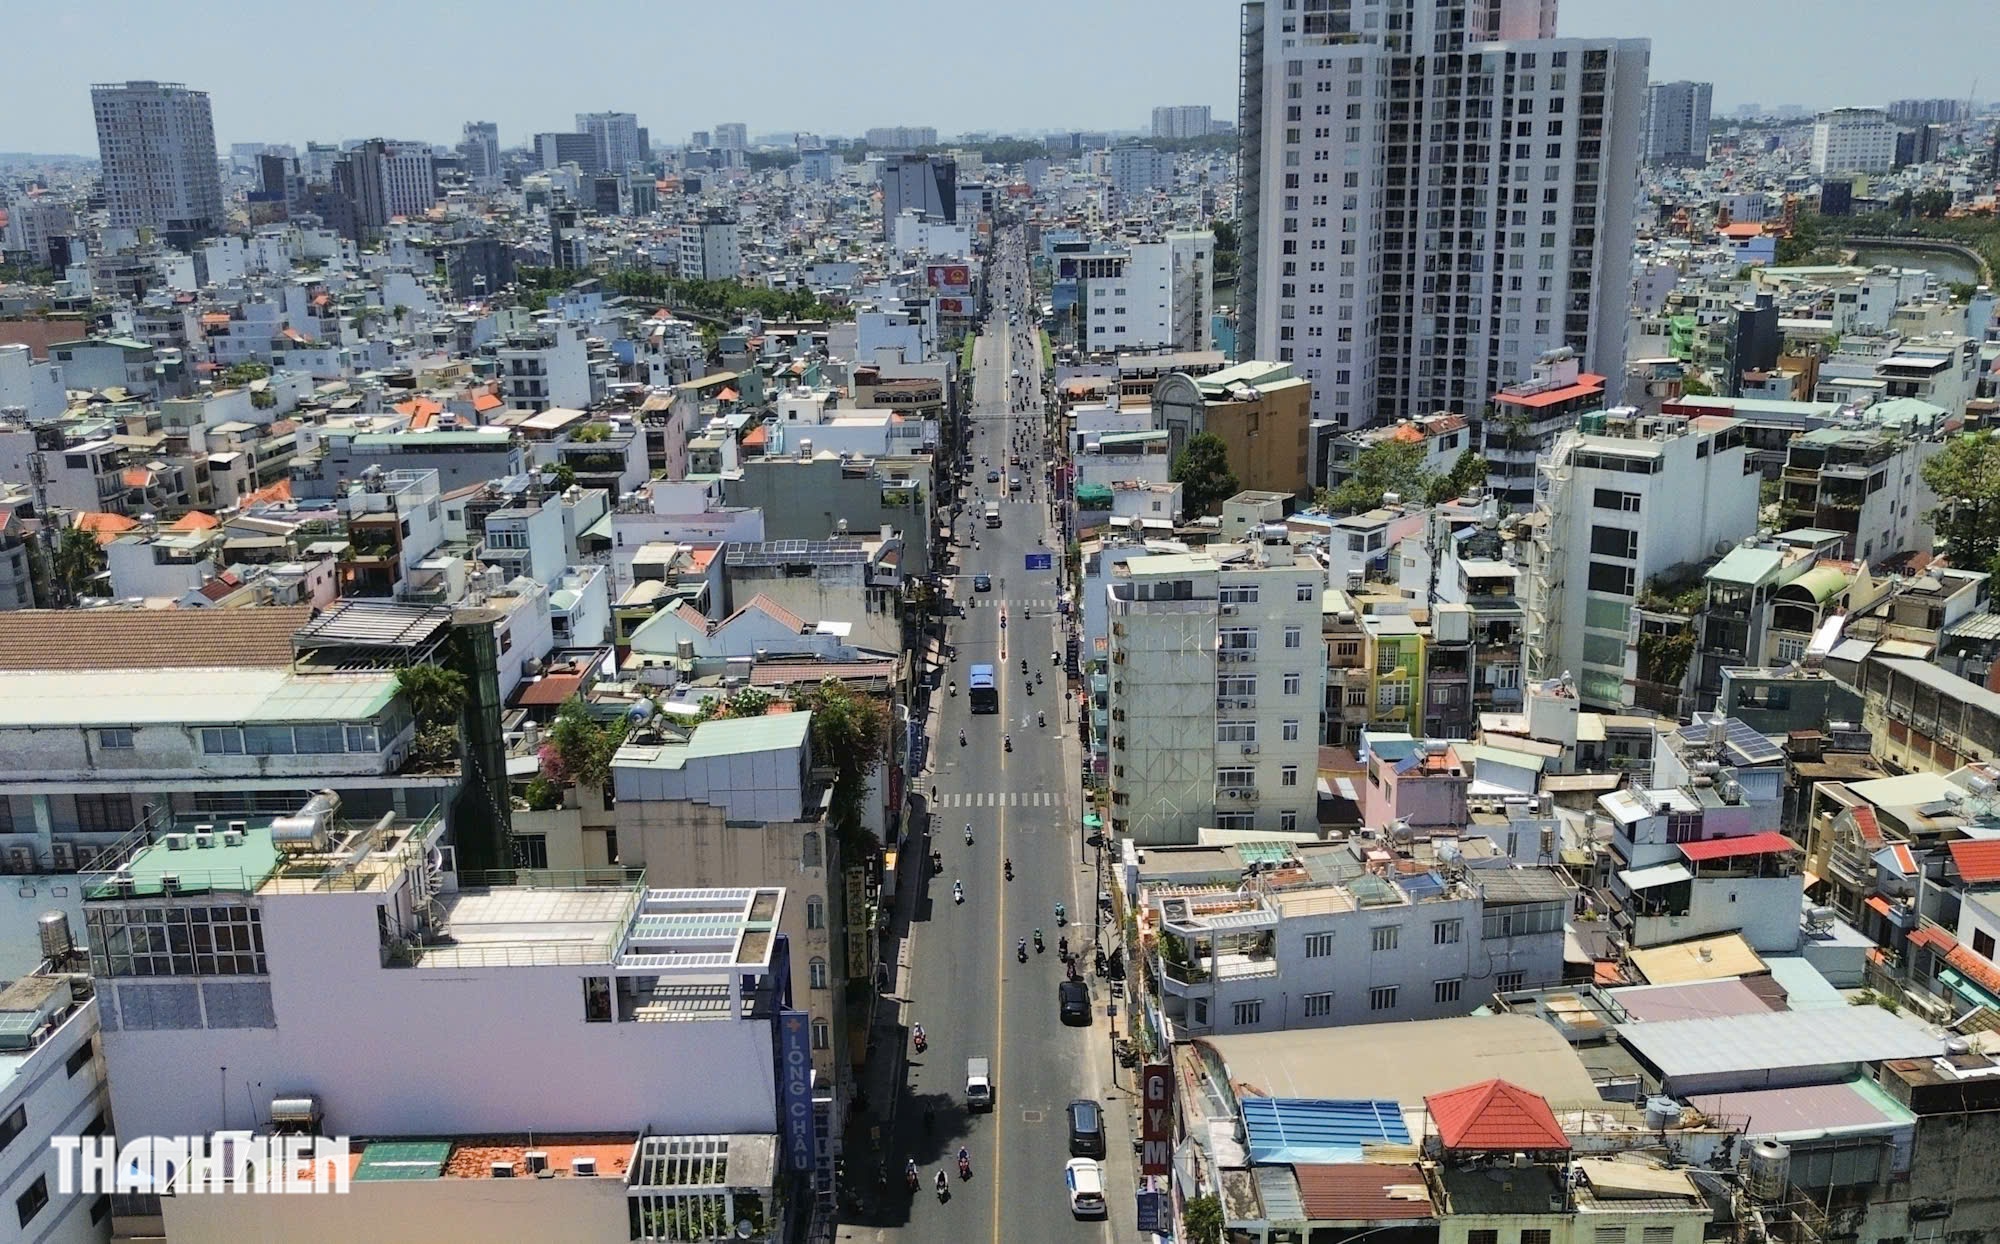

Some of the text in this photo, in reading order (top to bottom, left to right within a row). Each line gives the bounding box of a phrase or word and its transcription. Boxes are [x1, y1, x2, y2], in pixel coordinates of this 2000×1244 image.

[787, 1035, 808, 1169] LONG CHÂU
[1144, 1075, 1168, 1165] GYM
